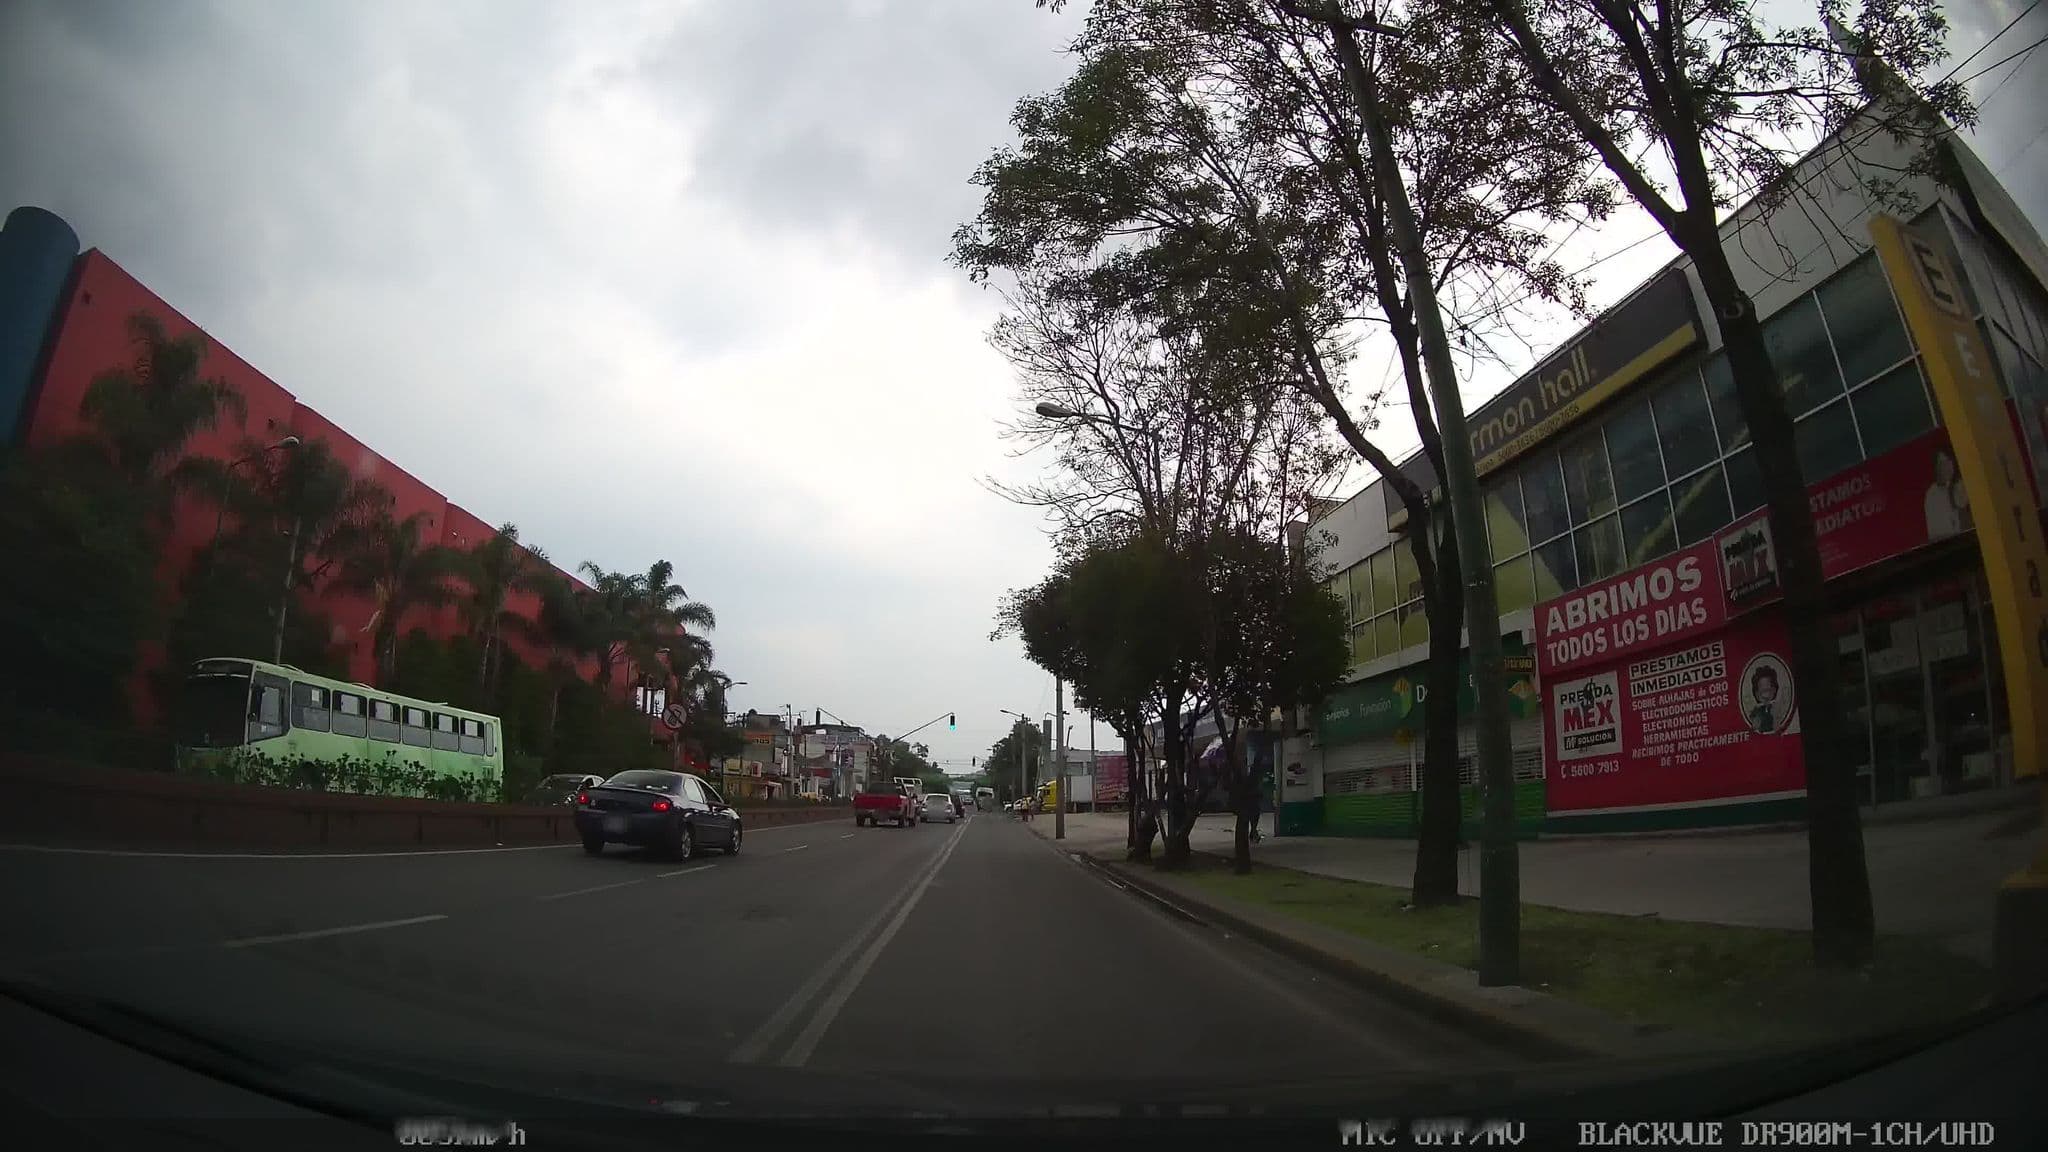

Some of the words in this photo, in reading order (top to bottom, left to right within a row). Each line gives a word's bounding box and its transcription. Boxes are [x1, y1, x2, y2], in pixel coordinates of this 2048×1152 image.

[1469, 397, 1535, 457] rmon
[1809, 472, 1873, 512] STAMOS
[1546, 556, 1702, 637] ABRIMOS
[1546, 627, 1608, 667] TODOS
[1612, 613, 1650, 649] LOS
[1655, 597, 1708, 637] DIAS
[1630, 643, 1721, 678] PRESTAMOS
[1632, 663, 1724, 696] INMEDIATOS
[1632, 697, 1657, 711] SOBRE
[1659, 689, 1696, 706] ALHAJAS
[1709, 681, 1728, 695] ORO
[1563, 700, 1616, 733] MEX
[1641, 694, 1729, 721] ELECTRODOMESTICOS
[1643, 711, 1708, 733] ELECTRONICOS
[1632, 743, 1675, 760] RECIBIMOS
[1678, 731, 1751, 752] PRACTICAMENTE
[1643, 725, 1709, 745] HERRAMIENTAS
[1660, 756, 1671, 767] DE
[1675, 752, 1700, 766] TODO
